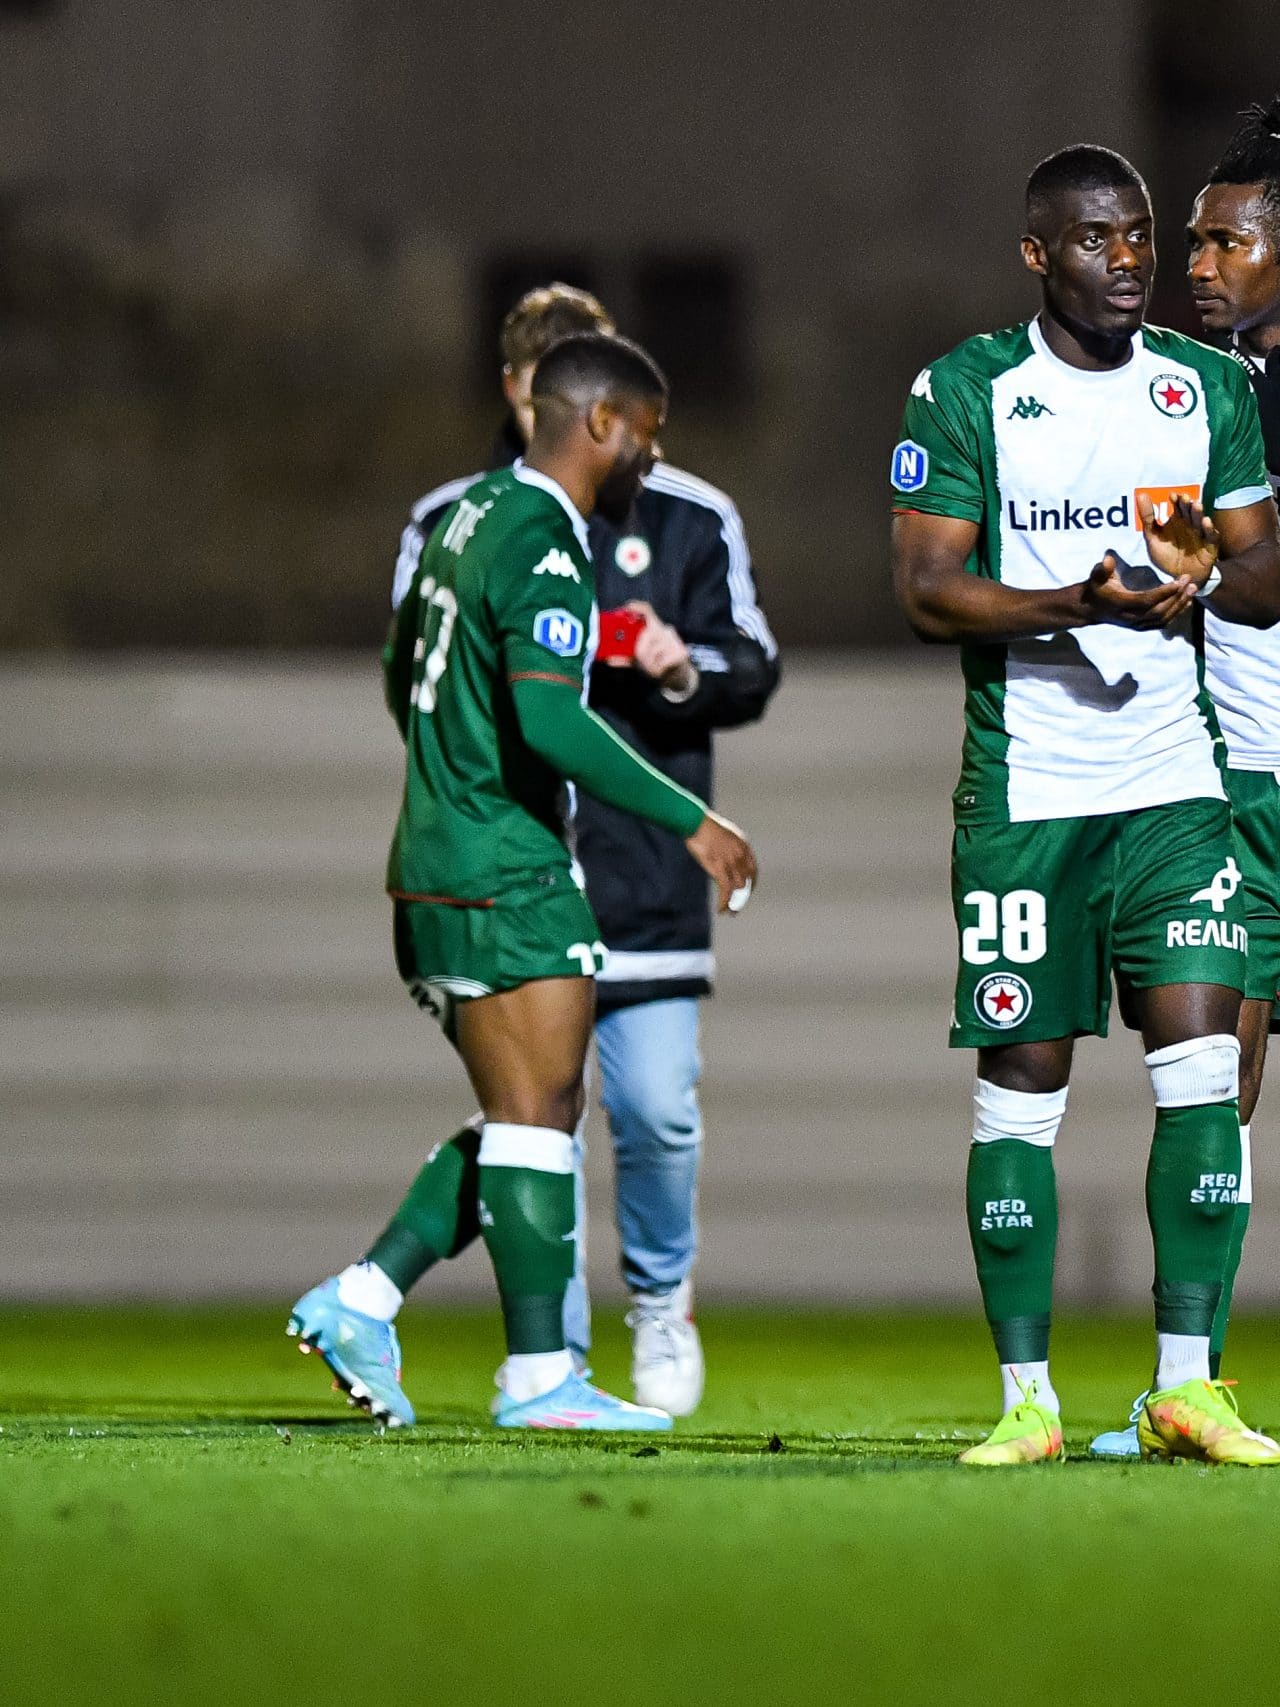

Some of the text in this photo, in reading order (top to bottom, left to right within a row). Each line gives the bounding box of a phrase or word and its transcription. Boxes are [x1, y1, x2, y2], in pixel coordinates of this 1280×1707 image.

[1008, 495, 1129, 531] Linked
[962, 888, 1047, 965] 28
[1167, 919, 1248, 957] REALIT
[1200, 1173, 1237, 1188] RED
[1190, 1189, 1238, 1204] STAR
[985, 1199, 1026, 1215] RED
[981, 1215, 1033, 1230] STAR
